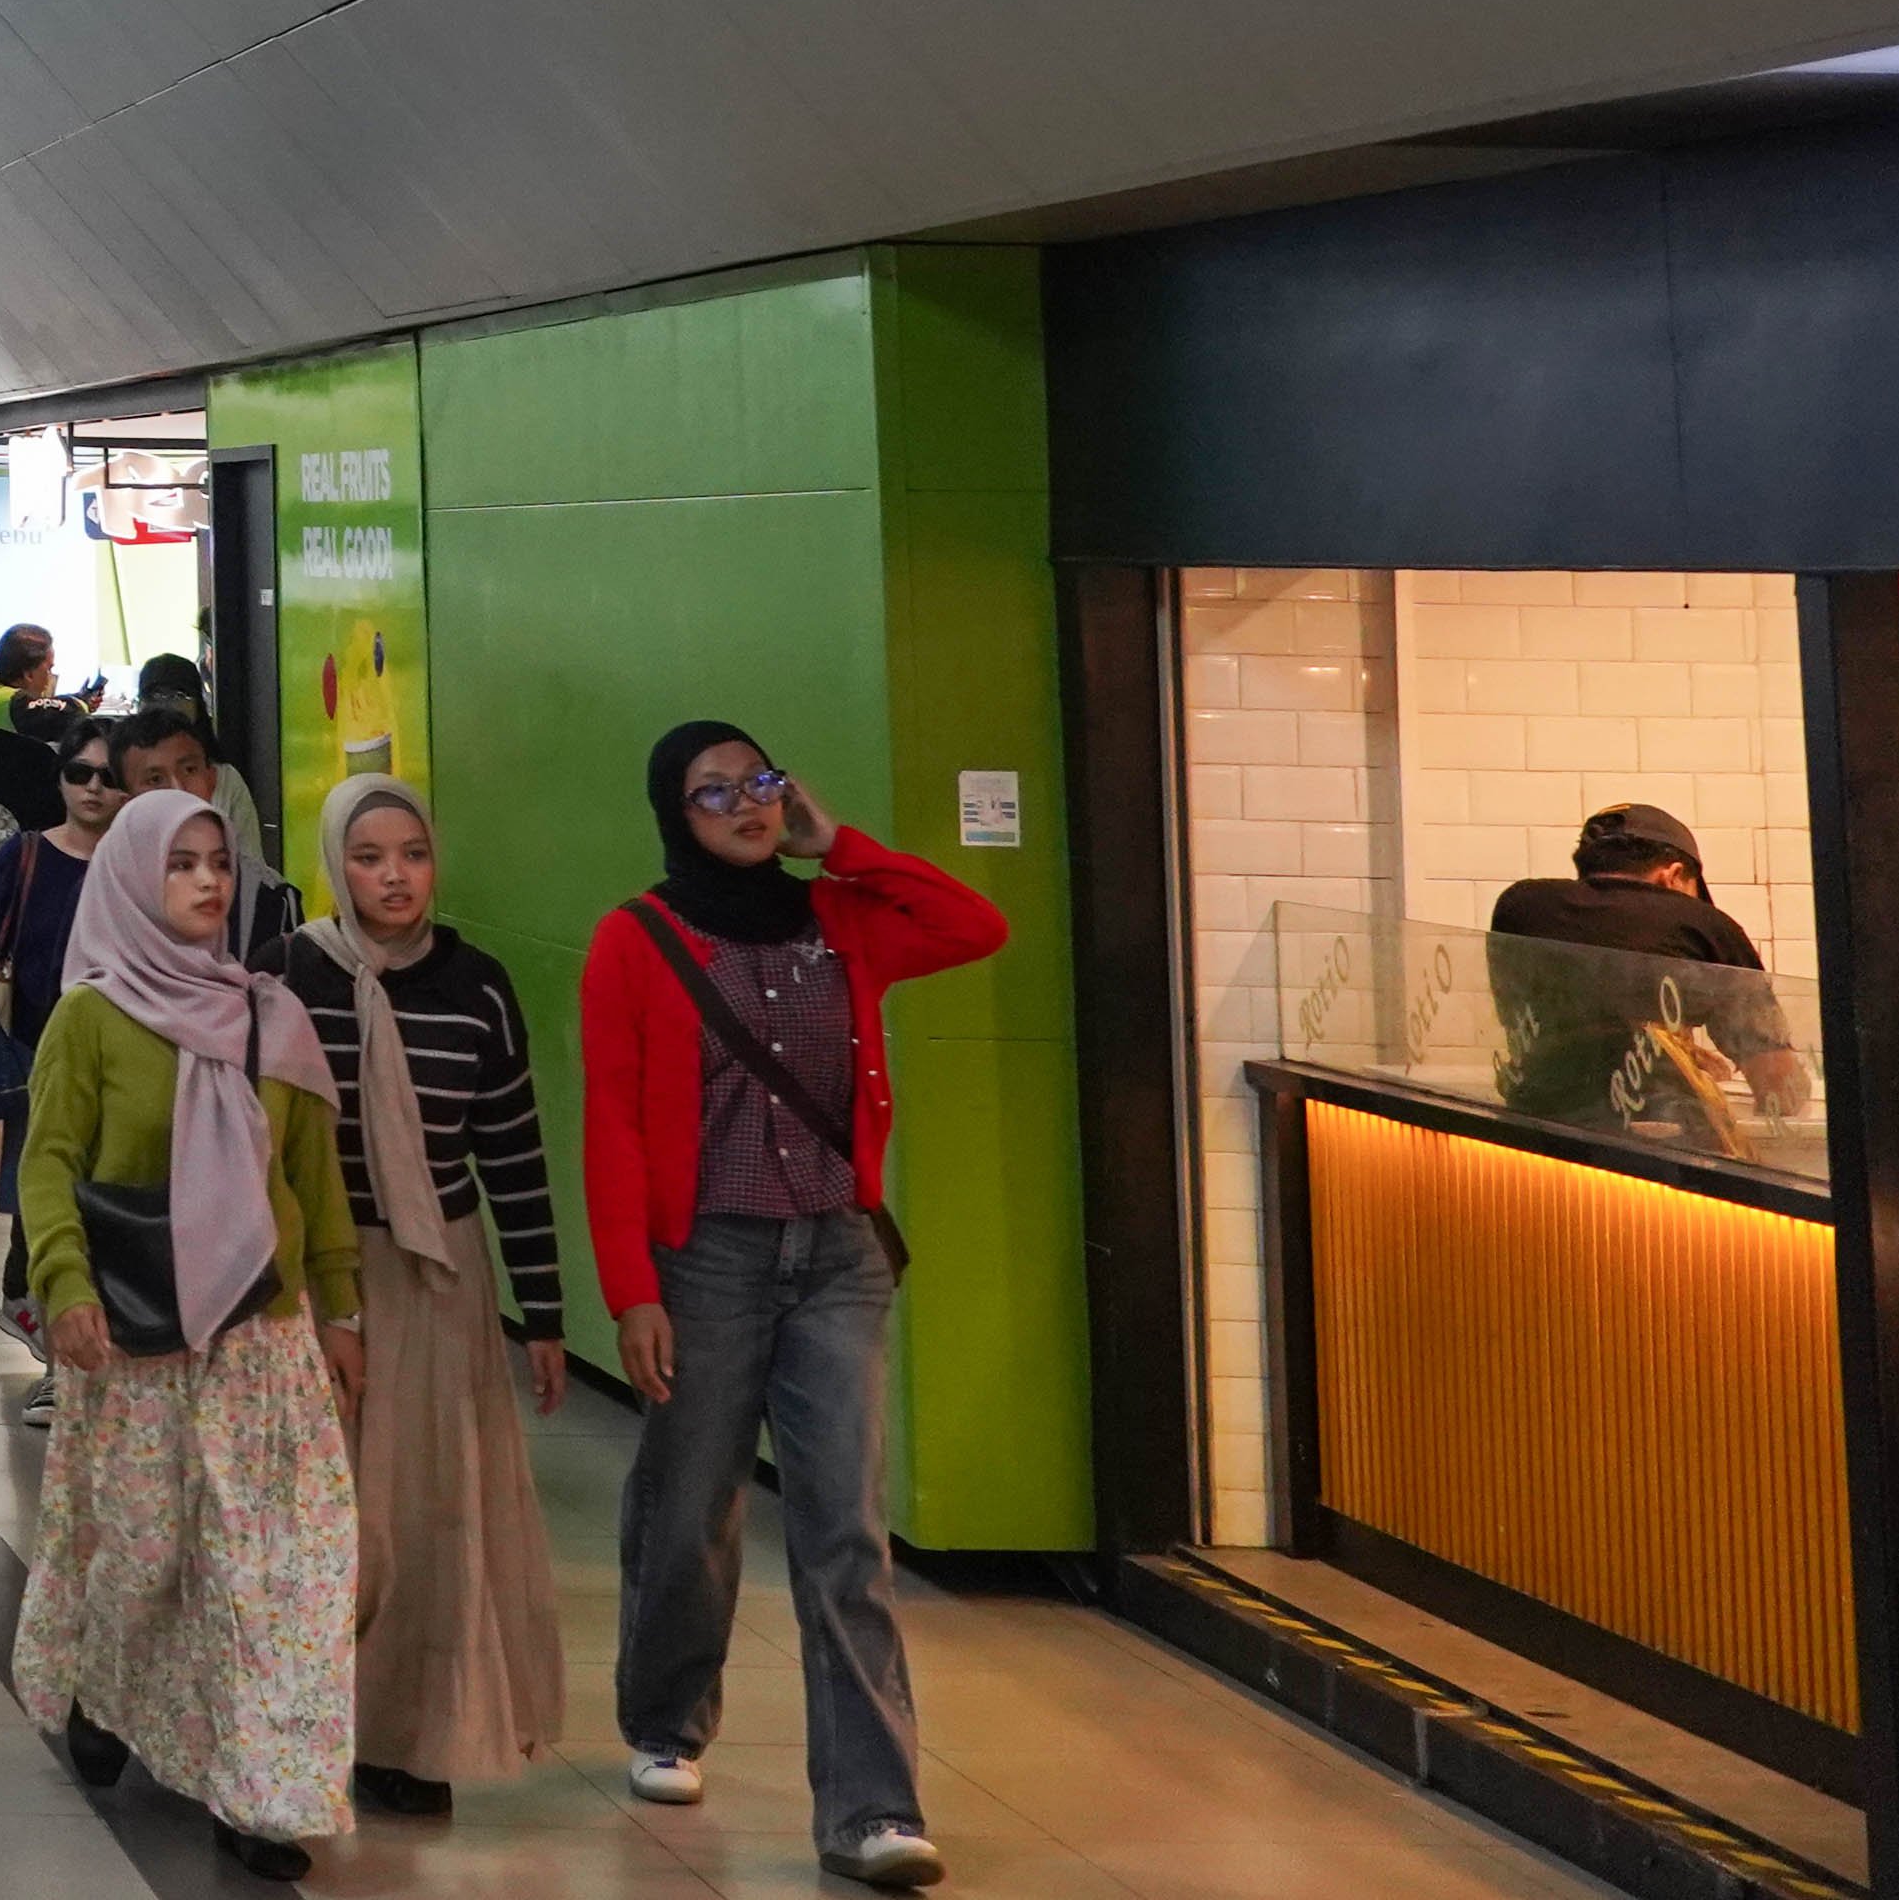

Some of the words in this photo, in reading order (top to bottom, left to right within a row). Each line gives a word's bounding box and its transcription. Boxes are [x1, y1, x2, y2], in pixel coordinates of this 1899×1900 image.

[301, 452, 340, 502] REAL
[340, 448, 391, 502] FRUITS
[303, 526, 342, 579] REAL
[343, 526, 392, 581] GOOD!
[27, 698, 68, 712] gopay
